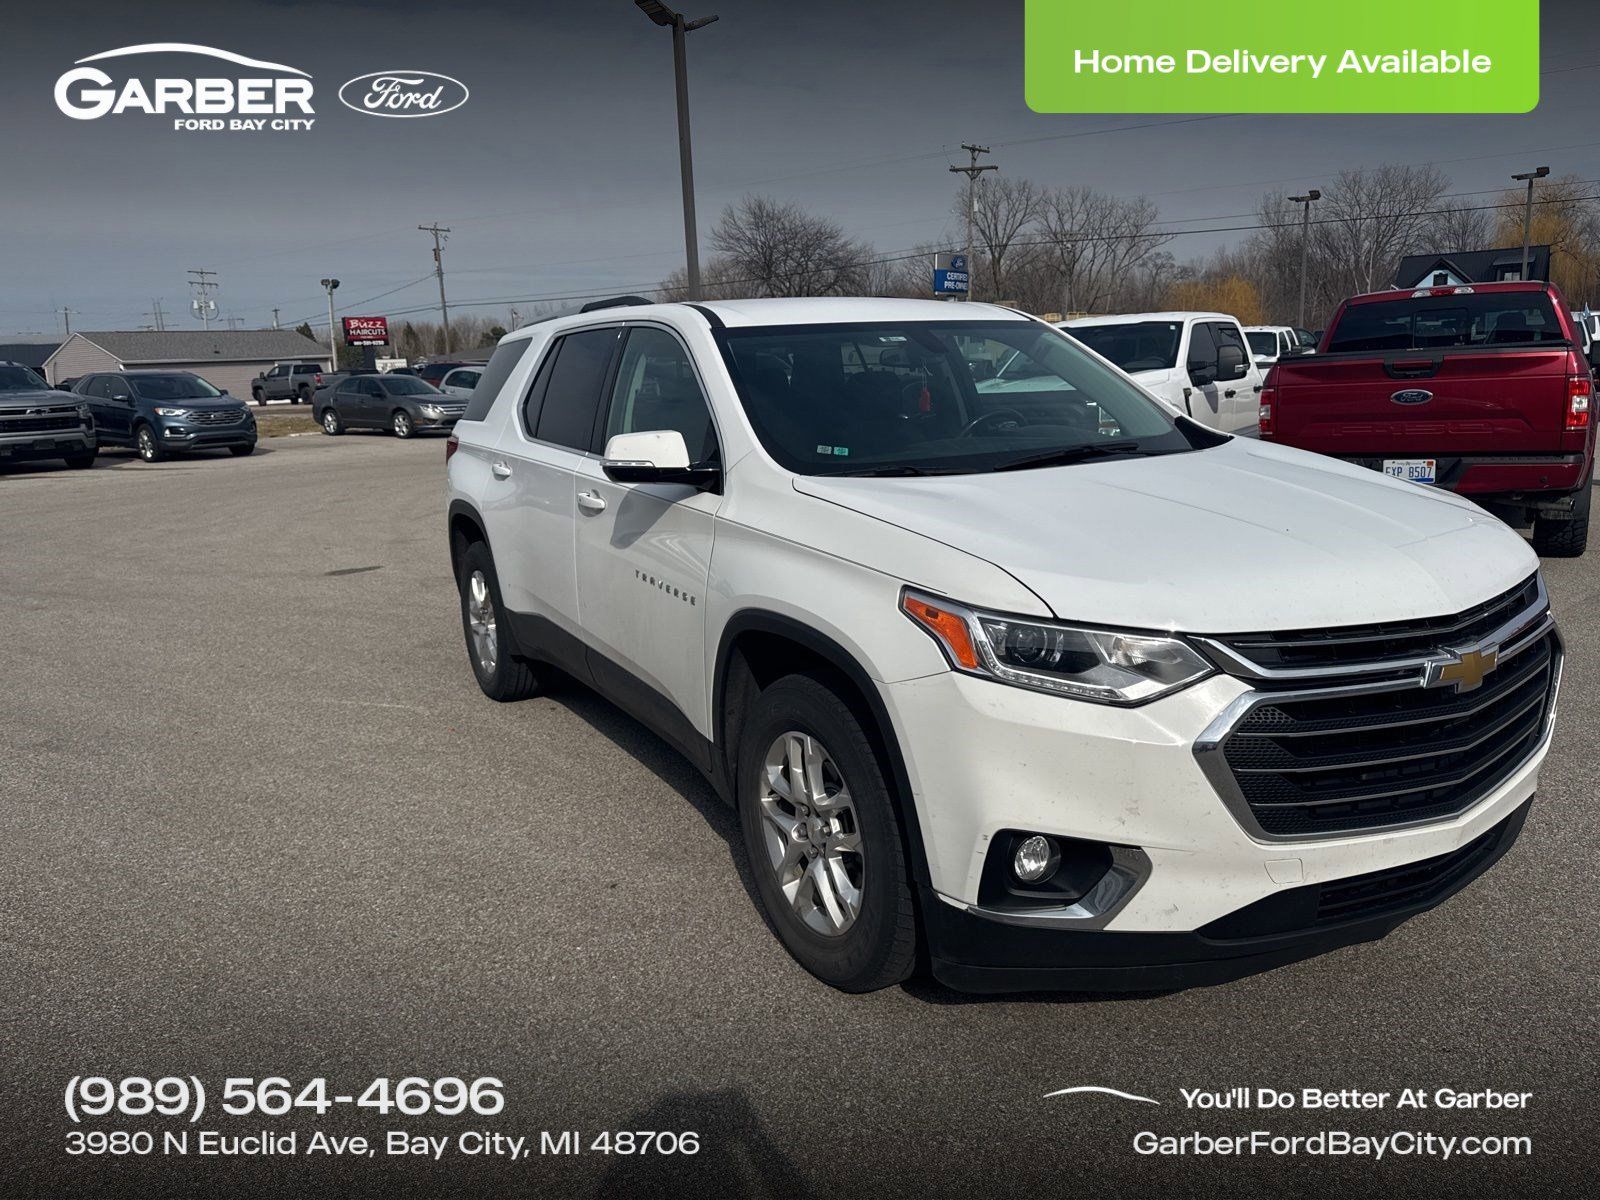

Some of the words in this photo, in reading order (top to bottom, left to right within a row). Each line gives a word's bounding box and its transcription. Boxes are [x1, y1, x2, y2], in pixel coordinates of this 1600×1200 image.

[946, 272, 968, 281] CERTIFIE
[944, 281, 968, 289] PRE-OWNE
[1408, 466, 1433, 478] 8507
[635, 569, 696, 606] TRAVERSE
